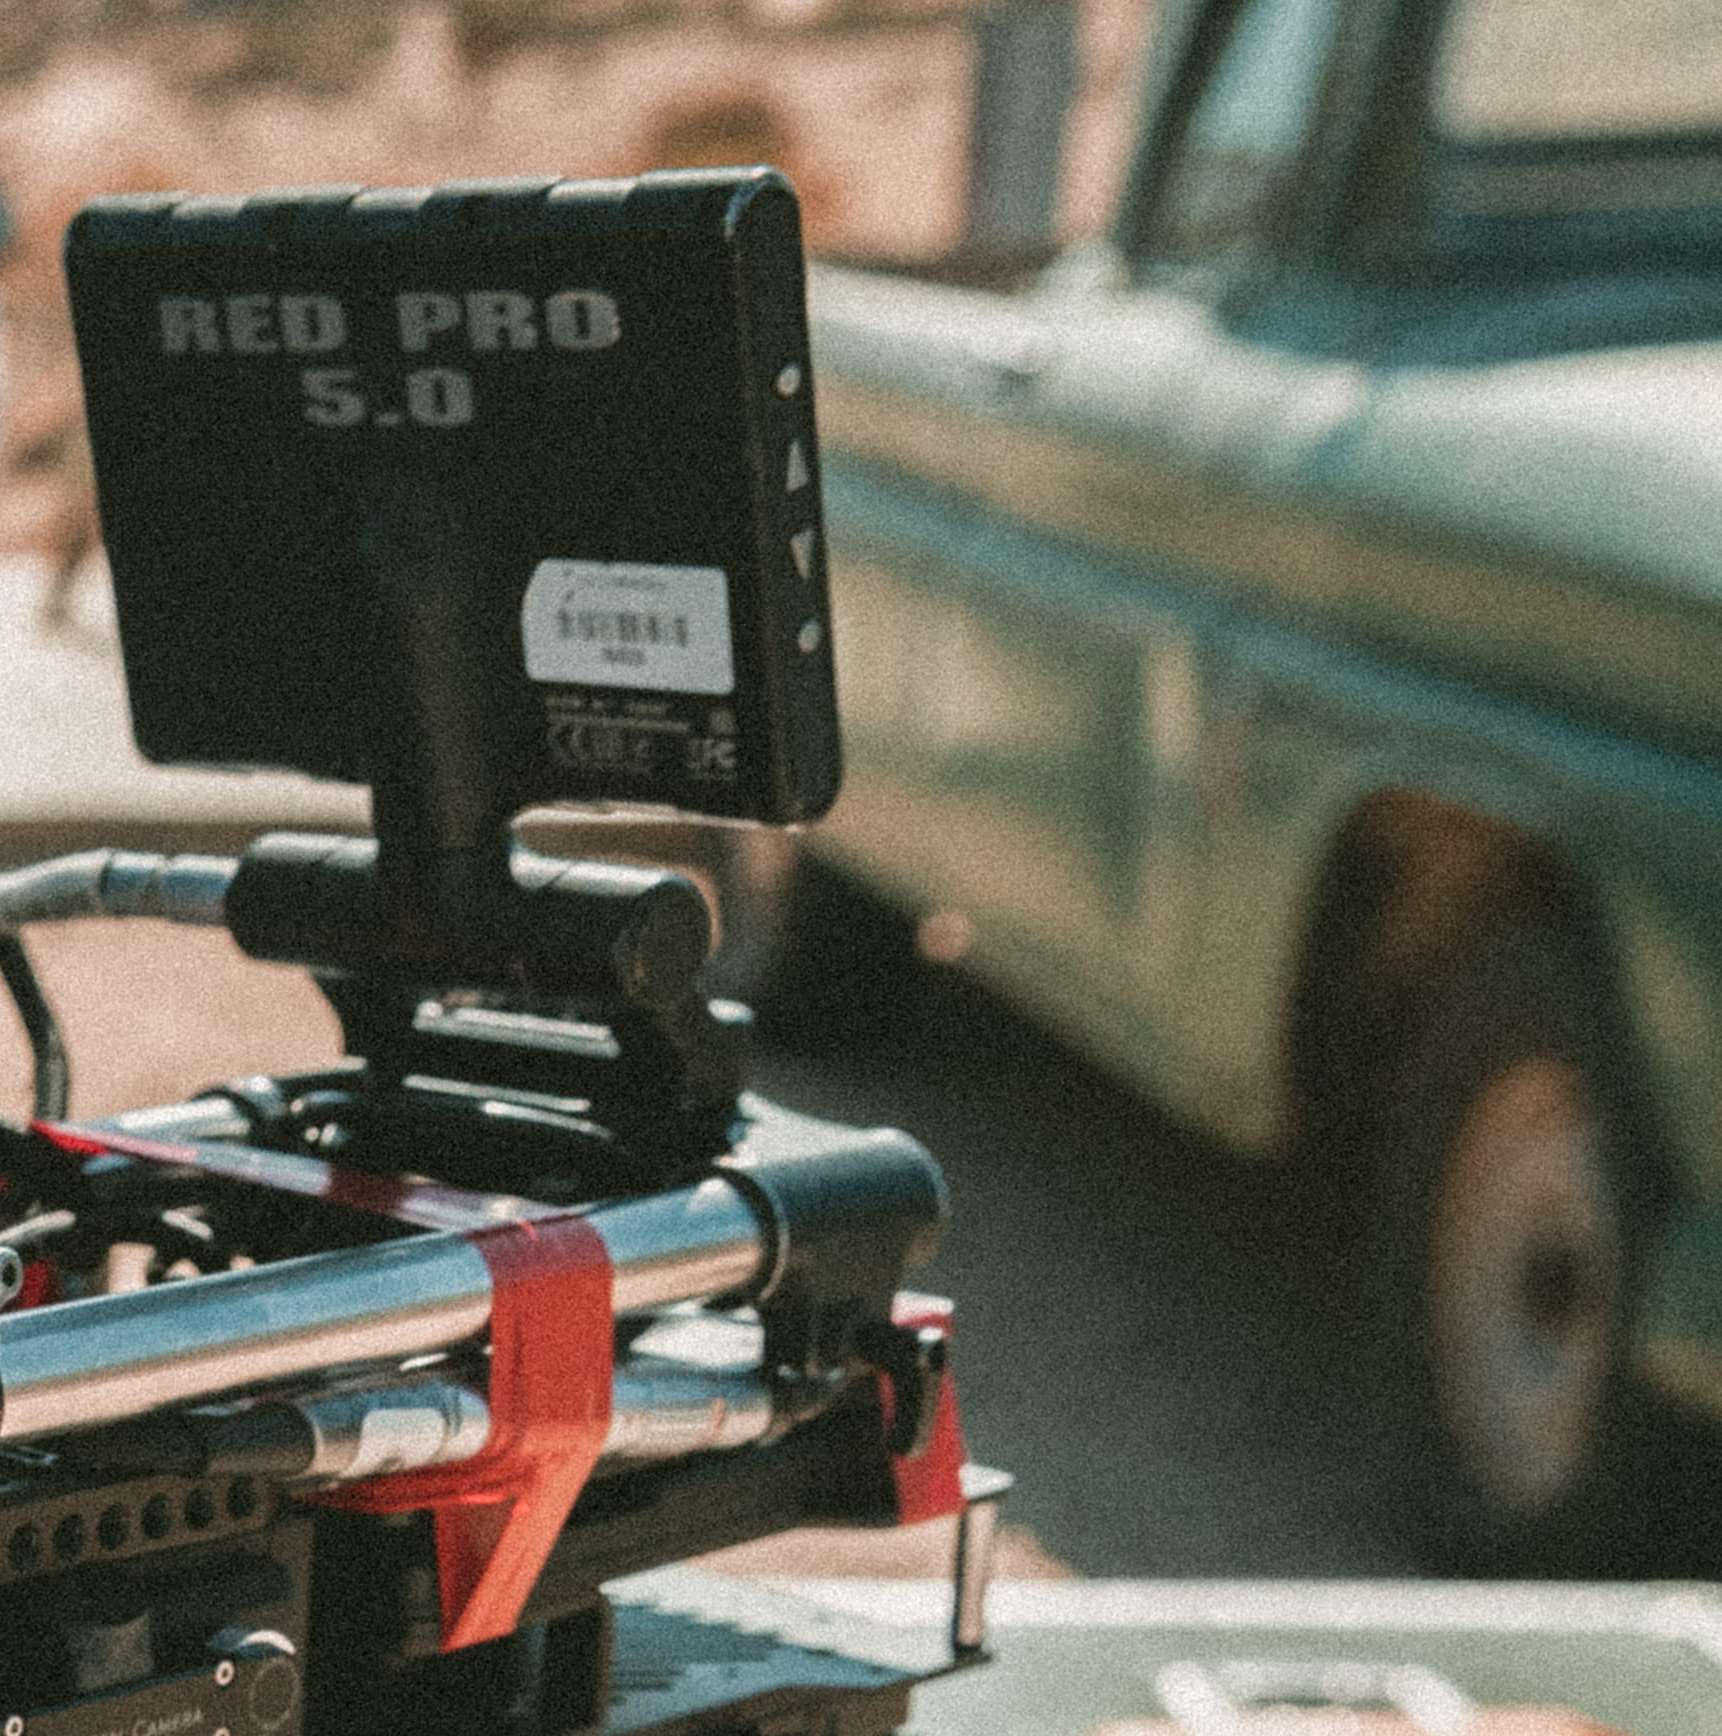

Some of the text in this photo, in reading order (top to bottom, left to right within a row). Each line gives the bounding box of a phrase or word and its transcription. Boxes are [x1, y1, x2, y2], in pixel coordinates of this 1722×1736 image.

[157, 289, 622, 353] RED PRO
[301, 366, 474, 428] 5.0
